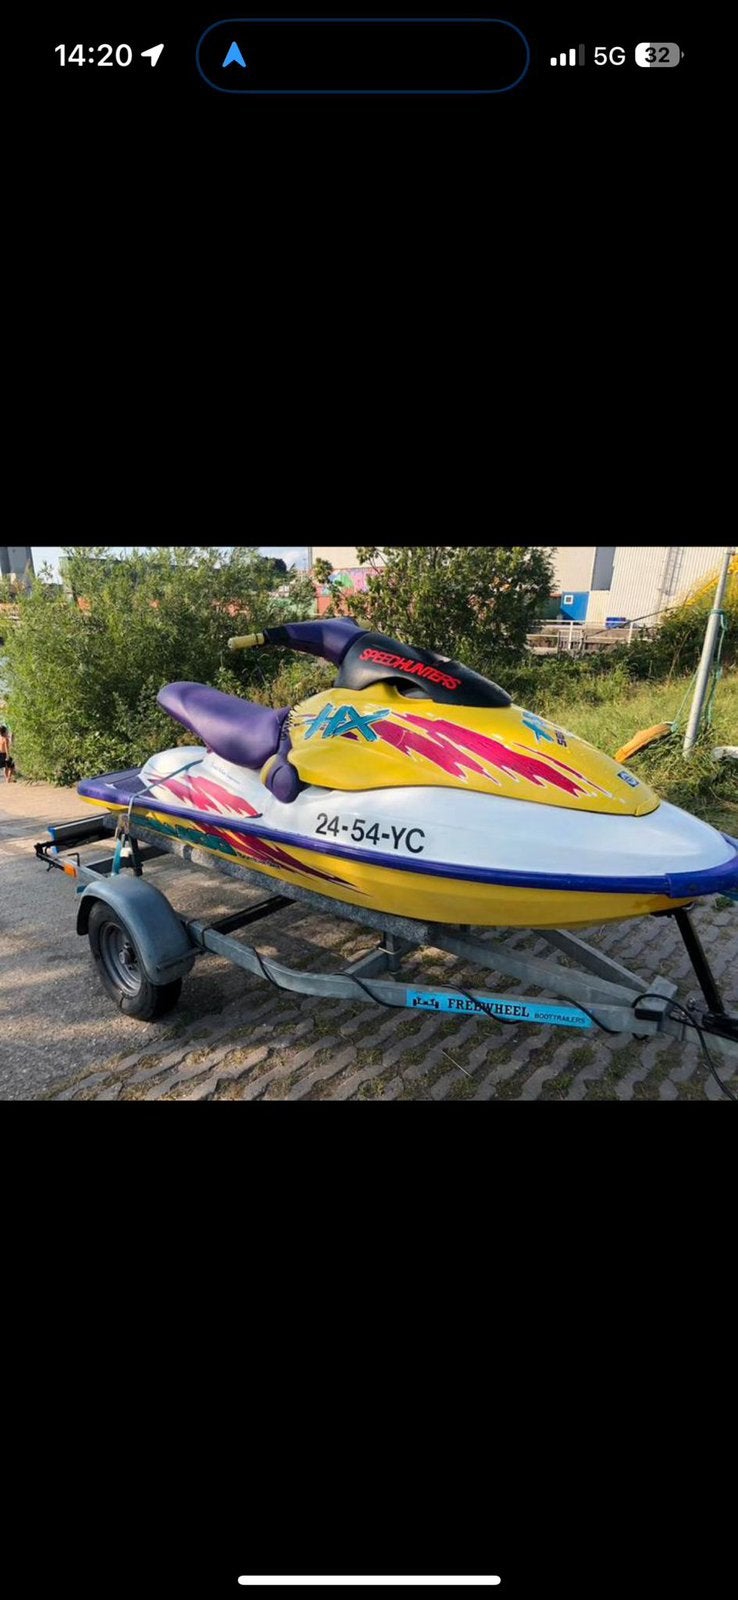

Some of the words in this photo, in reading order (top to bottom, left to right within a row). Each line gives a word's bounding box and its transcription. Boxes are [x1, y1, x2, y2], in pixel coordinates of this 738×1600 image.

[359, 648, 462, 690] SPEEDHUNTERS
[304, 702, 391, 742] HX
[315, 812, 426, 853] 24-54-YC
[534, 1012, 587, 1025] BOOTTRAILERS
